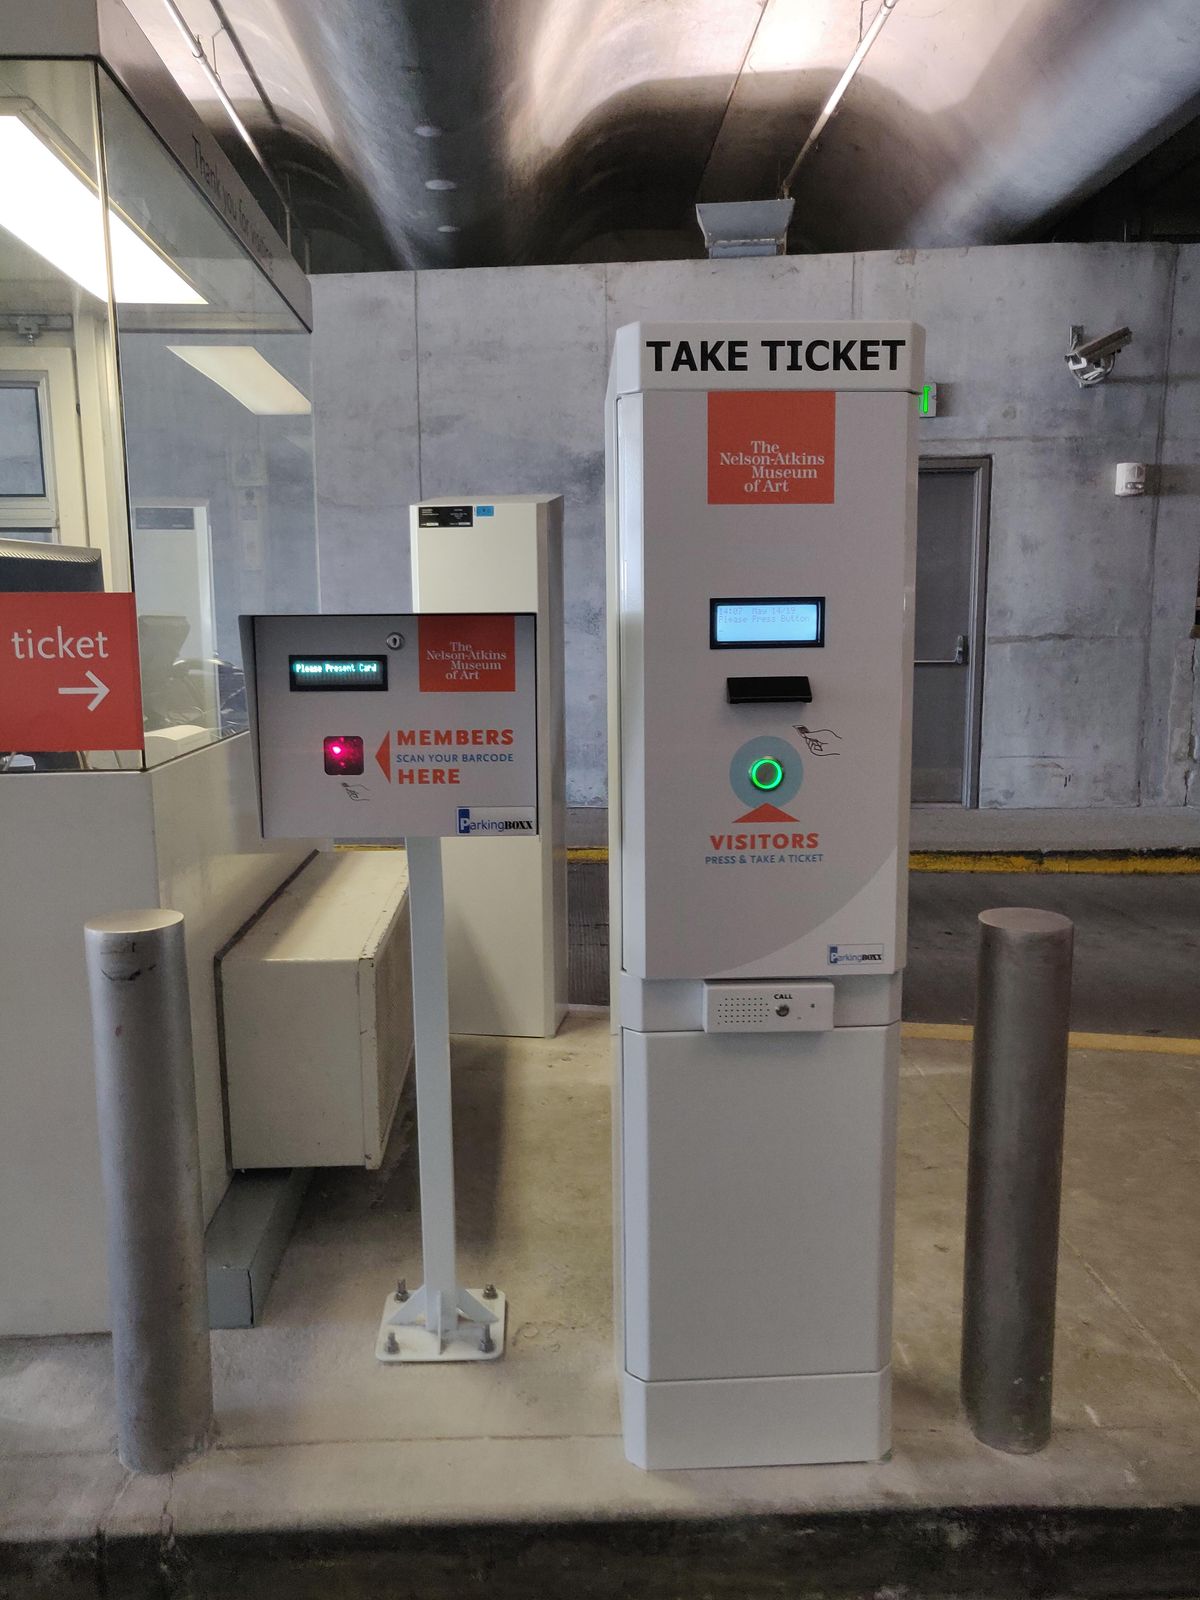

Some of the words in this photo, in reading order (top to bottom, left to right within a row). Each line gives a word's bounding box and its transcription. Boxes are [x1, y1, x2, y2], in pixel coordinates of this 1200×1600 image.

[191, 133, 220, 198] Thank
[646, 340, 748, 372] TAKE
[761, 339, 906, 371] TICKET
[751, 440, 779, 454] The
[720, 452, 825, 466] Nelson-Atkins
[752, 466, 817, 478] Museum
[744, 479, 761, 492] of
[762, 479, 789, 492] Art
[719, 615, 747, 624] Please
[752, 615, 775, 623] Press
[781, 614, 810, 623] Button
[11, 625, 109, 659] ticket
[450, 641, 472, 652] The
[426, 650, 507, 661] Nelson-Atkins
[295, 663, 322, 673] Please
[325, 663, 356, 672] Present
[359, 663, 377, 672] Card
[451, 660, 501, 670] Museum
[445, 670, 459, 680] of
[460, 670, 480, 680] Art
[397, 729, 514, 746] MEMBERS
[396, 754, 425, 763] SCAN
[429, 754, 458, 763] YOUR
[462, 753, 514, 762] BARCODE
[398, 768, 461, 785] HERE
[459, 815, 533, 833] ParkingBOXX
[709, 832, 819, 850] VISITORS
[705, 855, 736, 864] PRESS
[739, 855, 747, 864] &
[750, 855, 776, 863] TAKE
[778, 854, 786, 863] A
[788, 854, 824, 863] TICKET
[830, 951, 882, 963] ParkingBOXX
